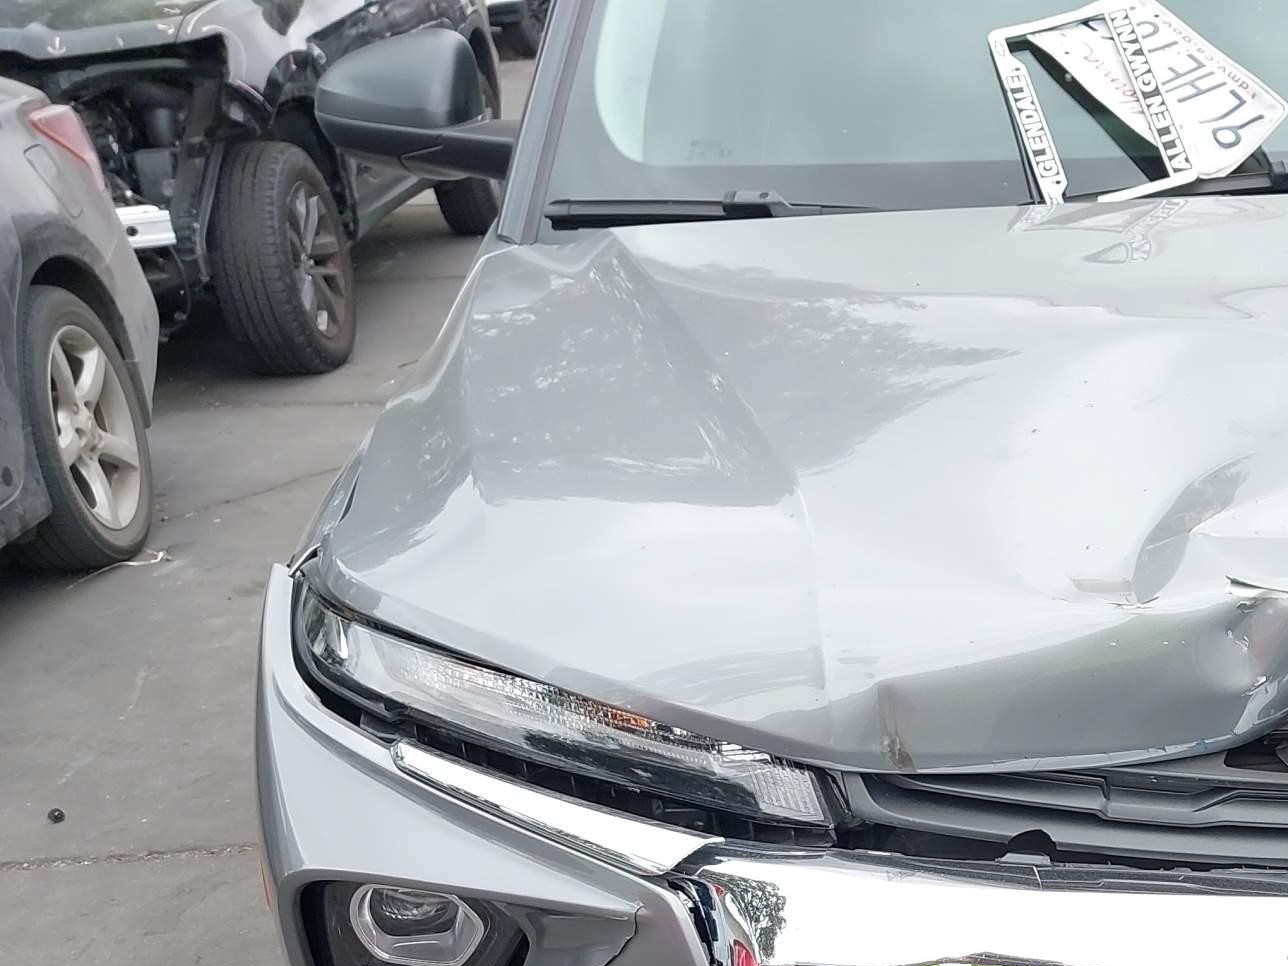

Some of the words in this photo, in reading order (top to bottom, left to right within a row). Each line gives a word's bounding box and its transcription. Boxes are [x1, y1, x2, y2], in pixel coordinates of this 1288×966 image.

[1109, 9, 1157, 93] GWYNN
[1162, 19, 1249, 91] dmv.ca.gov
[1006, 75, 1060, 178] GLENDALE
[1144, 96, 1192, 173] ALLEN
